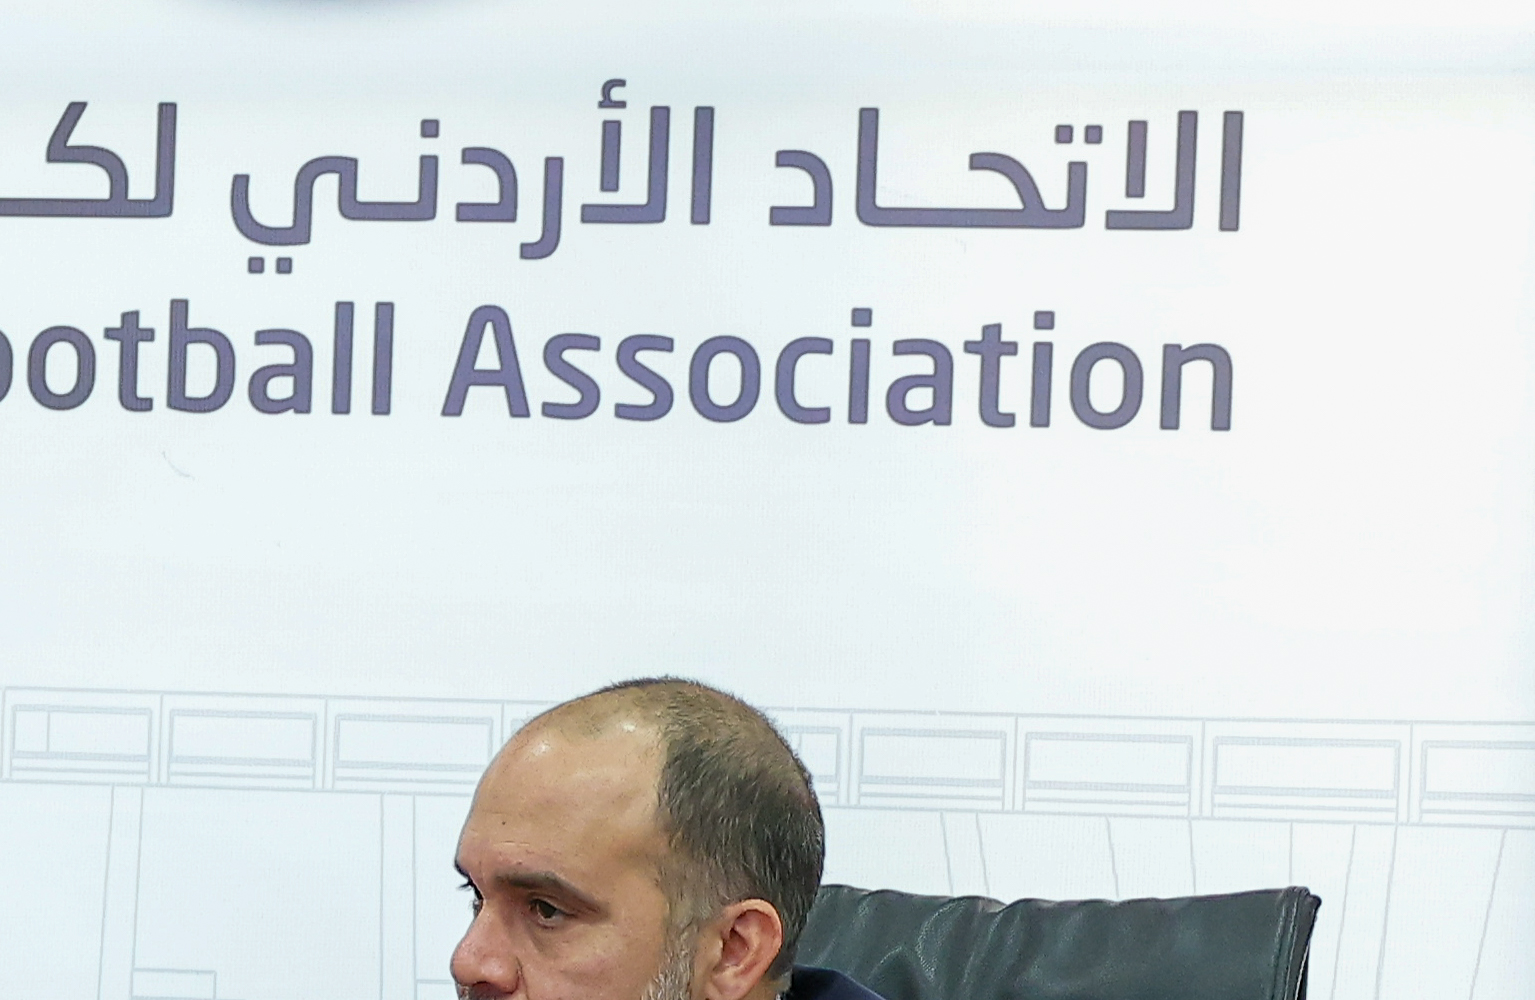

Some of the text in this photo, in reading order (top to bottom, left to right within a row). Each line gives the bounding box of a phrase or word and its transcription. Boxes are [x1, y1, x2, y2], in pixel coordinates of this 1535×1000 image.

[230, 78, 716, 276] الأردني
[768, 106, 1245, 232] الاتحاد
[440, 304, 1234, 432] Association
